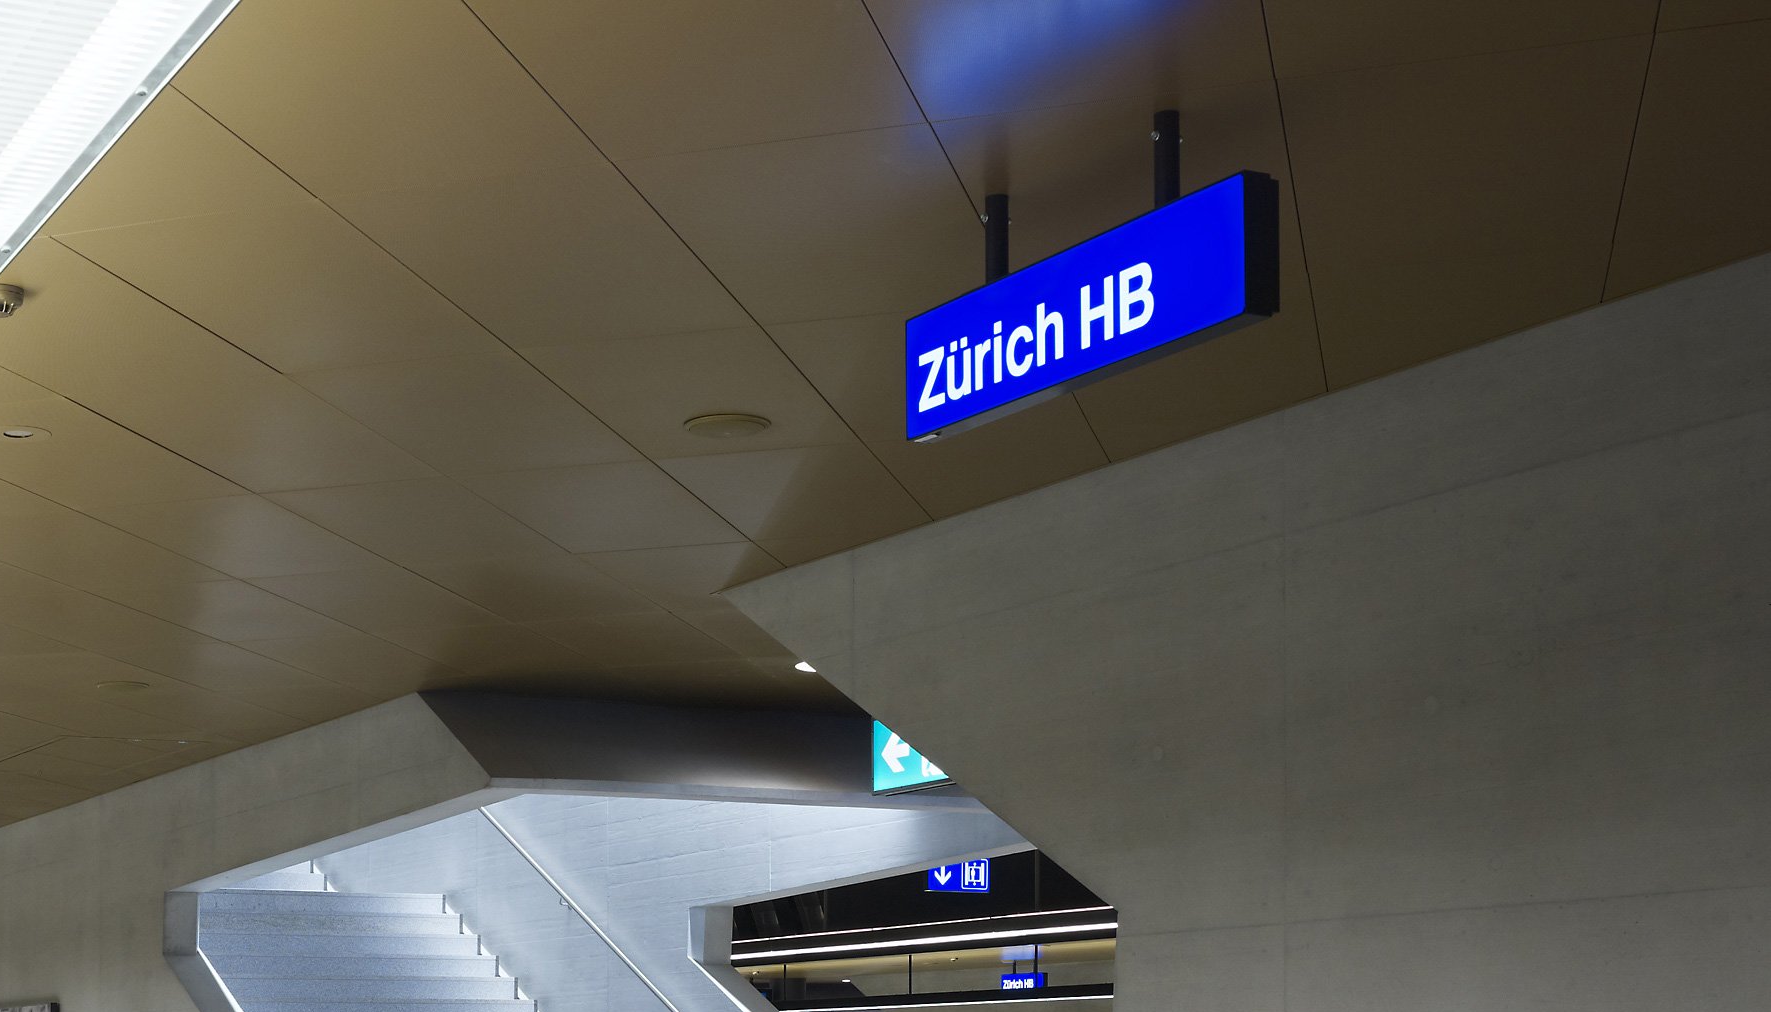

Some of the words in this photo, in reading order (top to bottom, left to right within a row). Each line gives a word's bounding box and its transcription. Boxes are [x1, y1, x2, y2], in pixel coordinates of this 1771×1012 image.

[918, 302, 1064, 413] Zürich
[1080, 262, 1155, 350] HB
[1003, 979, 1023, 989] Zürich
[1024, 979, 1034, 988] HB
